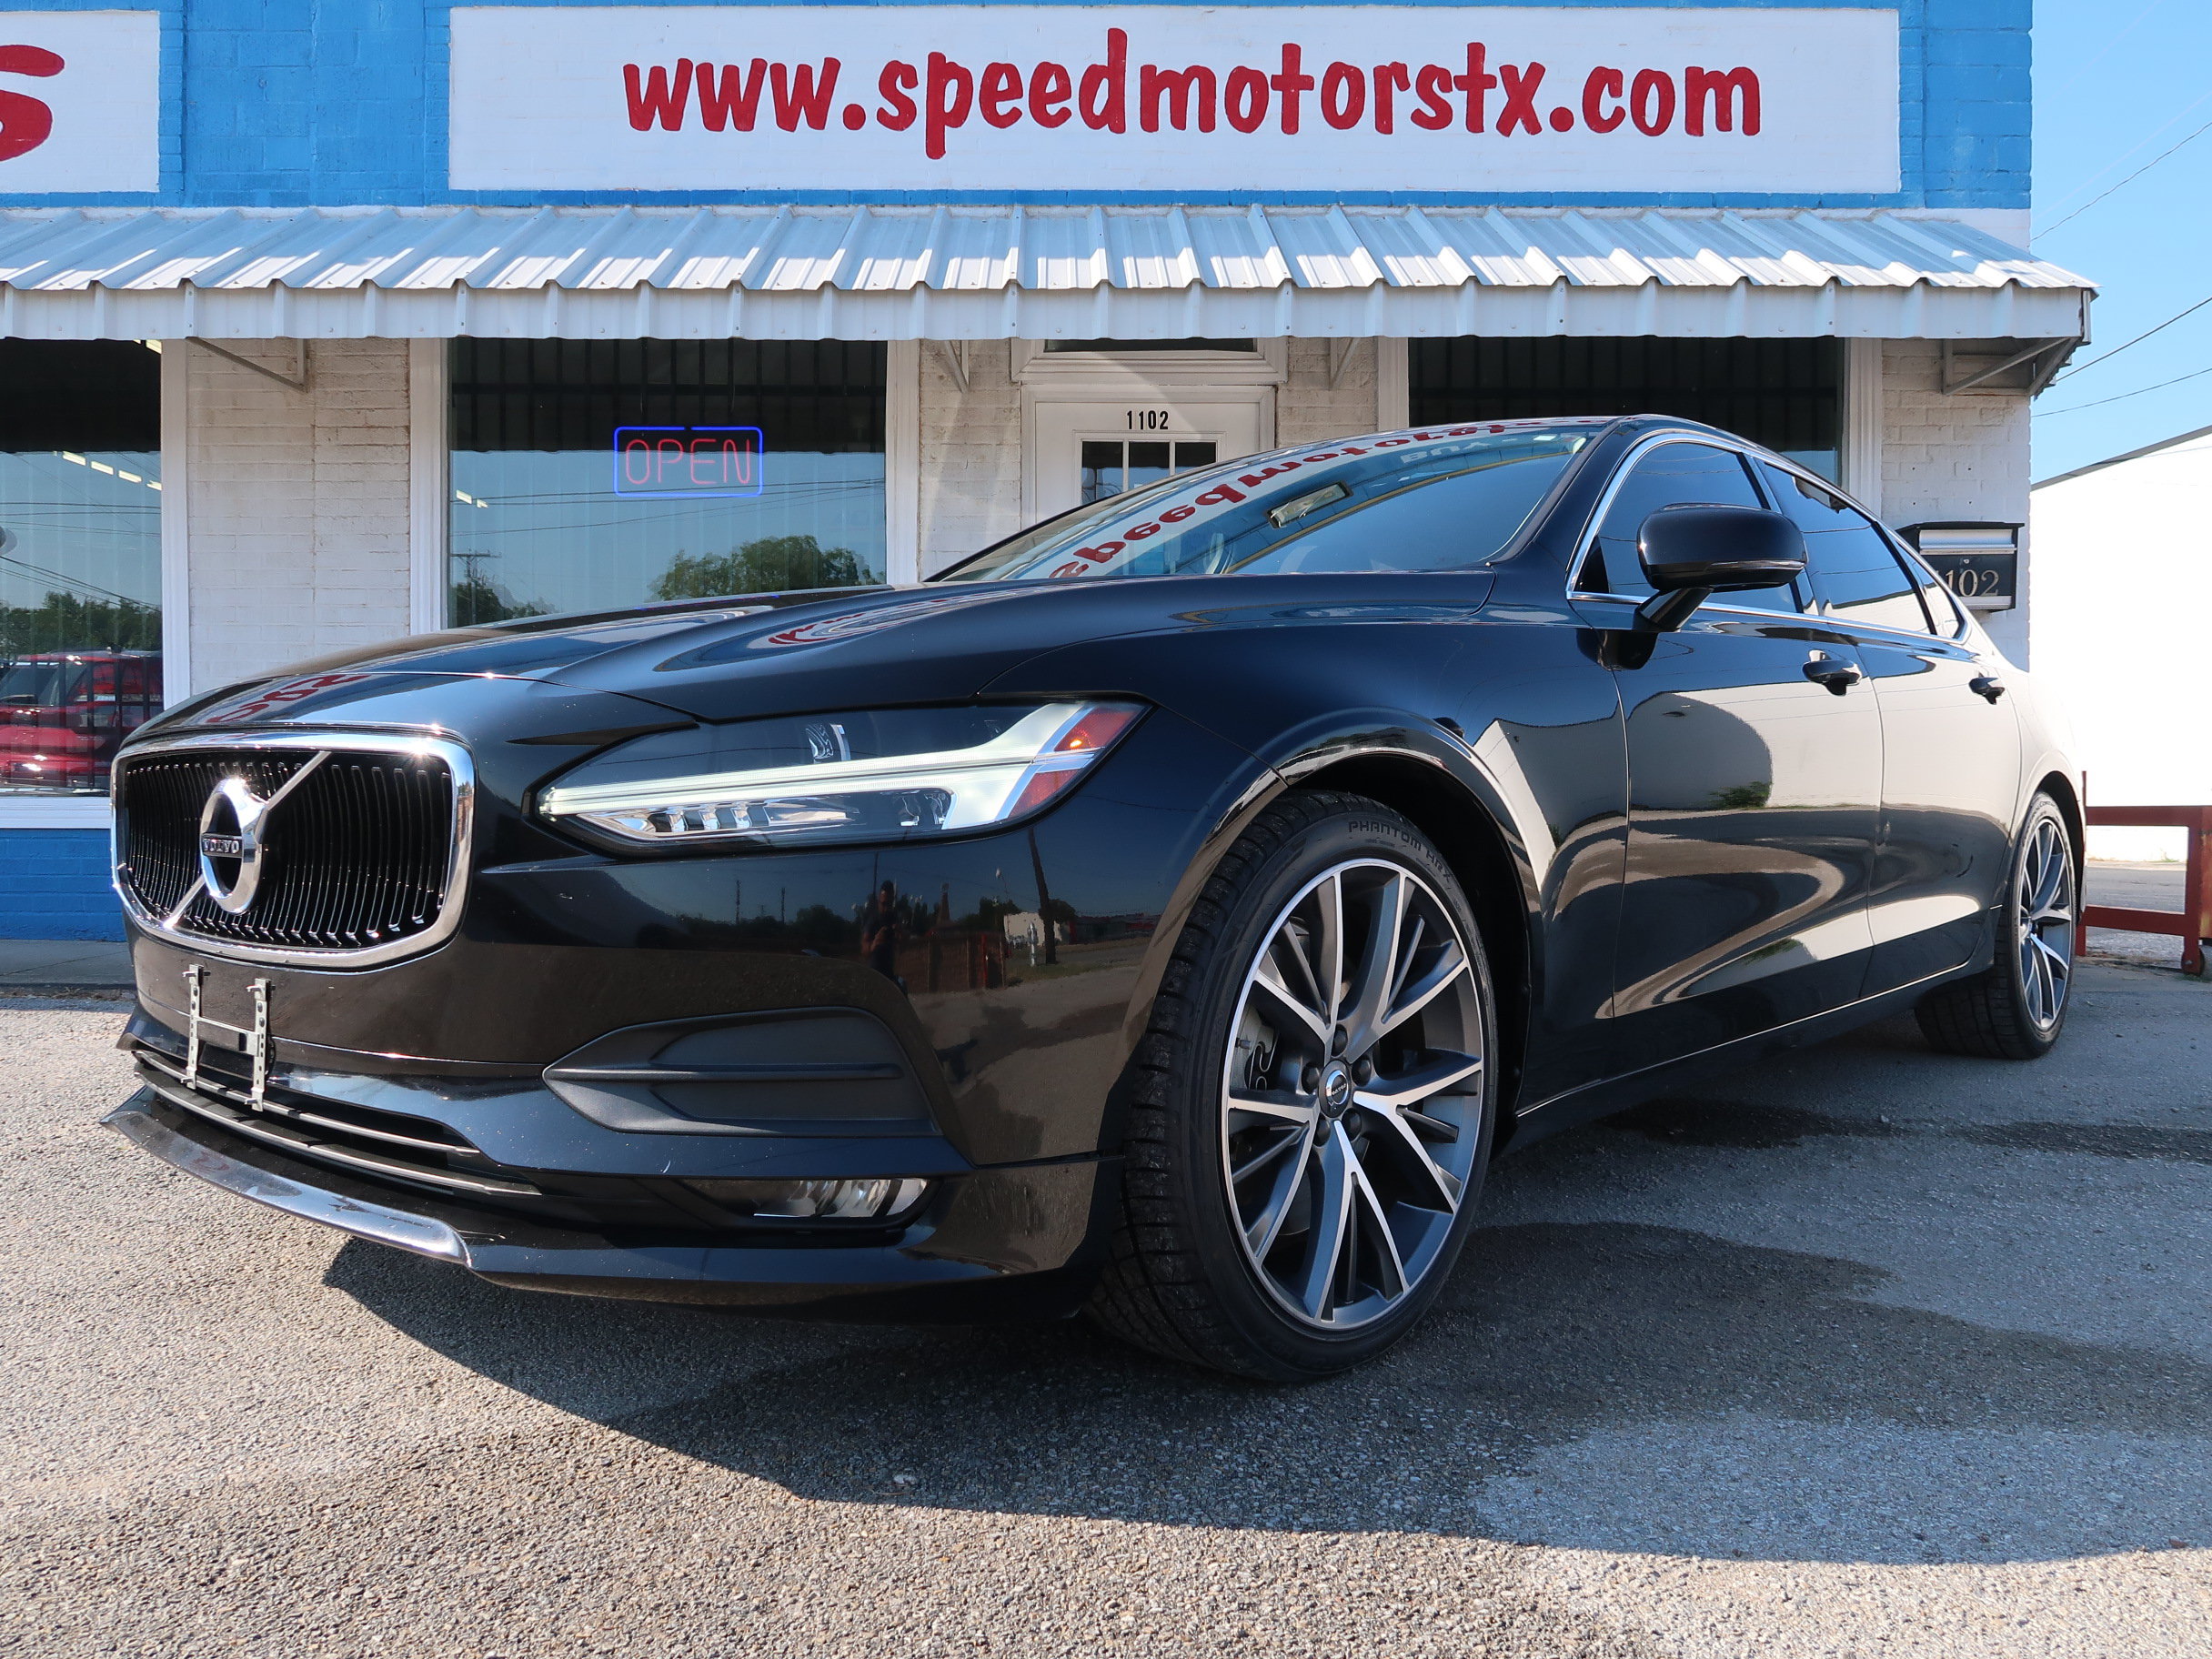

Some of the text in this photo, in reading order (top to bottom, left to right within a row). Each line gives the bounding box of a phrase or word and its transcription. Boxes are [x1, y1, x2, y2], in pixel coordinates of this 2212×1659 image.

[623, 28, 1761, 159] www.speedmotorstx.com
[1126, 409, 1170, 430] 1102
[625, 437, 751, 485] OPEN
[1936, 568, 2000, 597] 102
[202, 838, 240, 854] VOLVO
